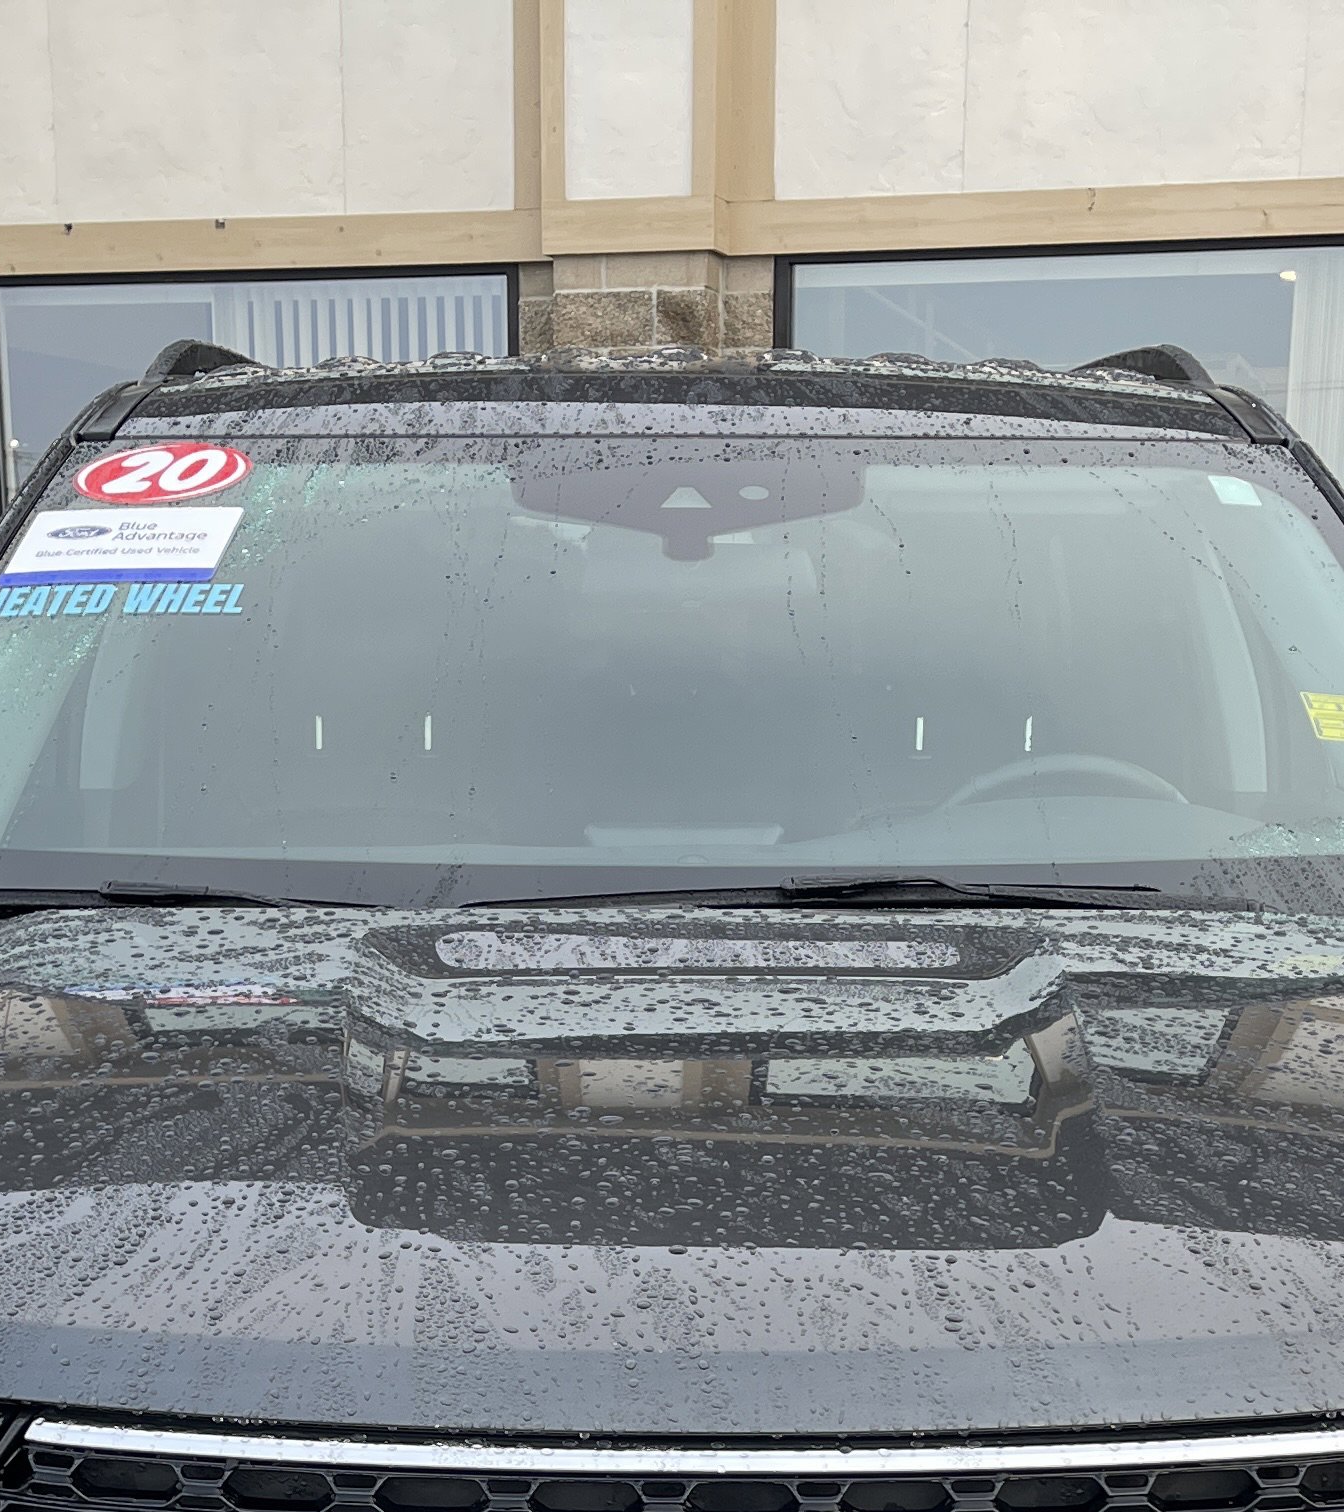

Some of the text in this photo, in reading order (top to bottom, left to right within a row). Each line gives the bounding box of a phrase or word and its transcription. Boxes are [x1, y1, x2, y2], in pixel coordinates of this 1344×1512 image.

[101, 449, 229, 495] 20
[118, 521, 158, 531] Blue
[112, 531, 207, 542] Advantage
[66, 547, 118, 556] Certified
[121, 547, 152, 555] Used
[157, 546, 200, 554] Vehicle
[123, 583, 245, 615] WHEEL
